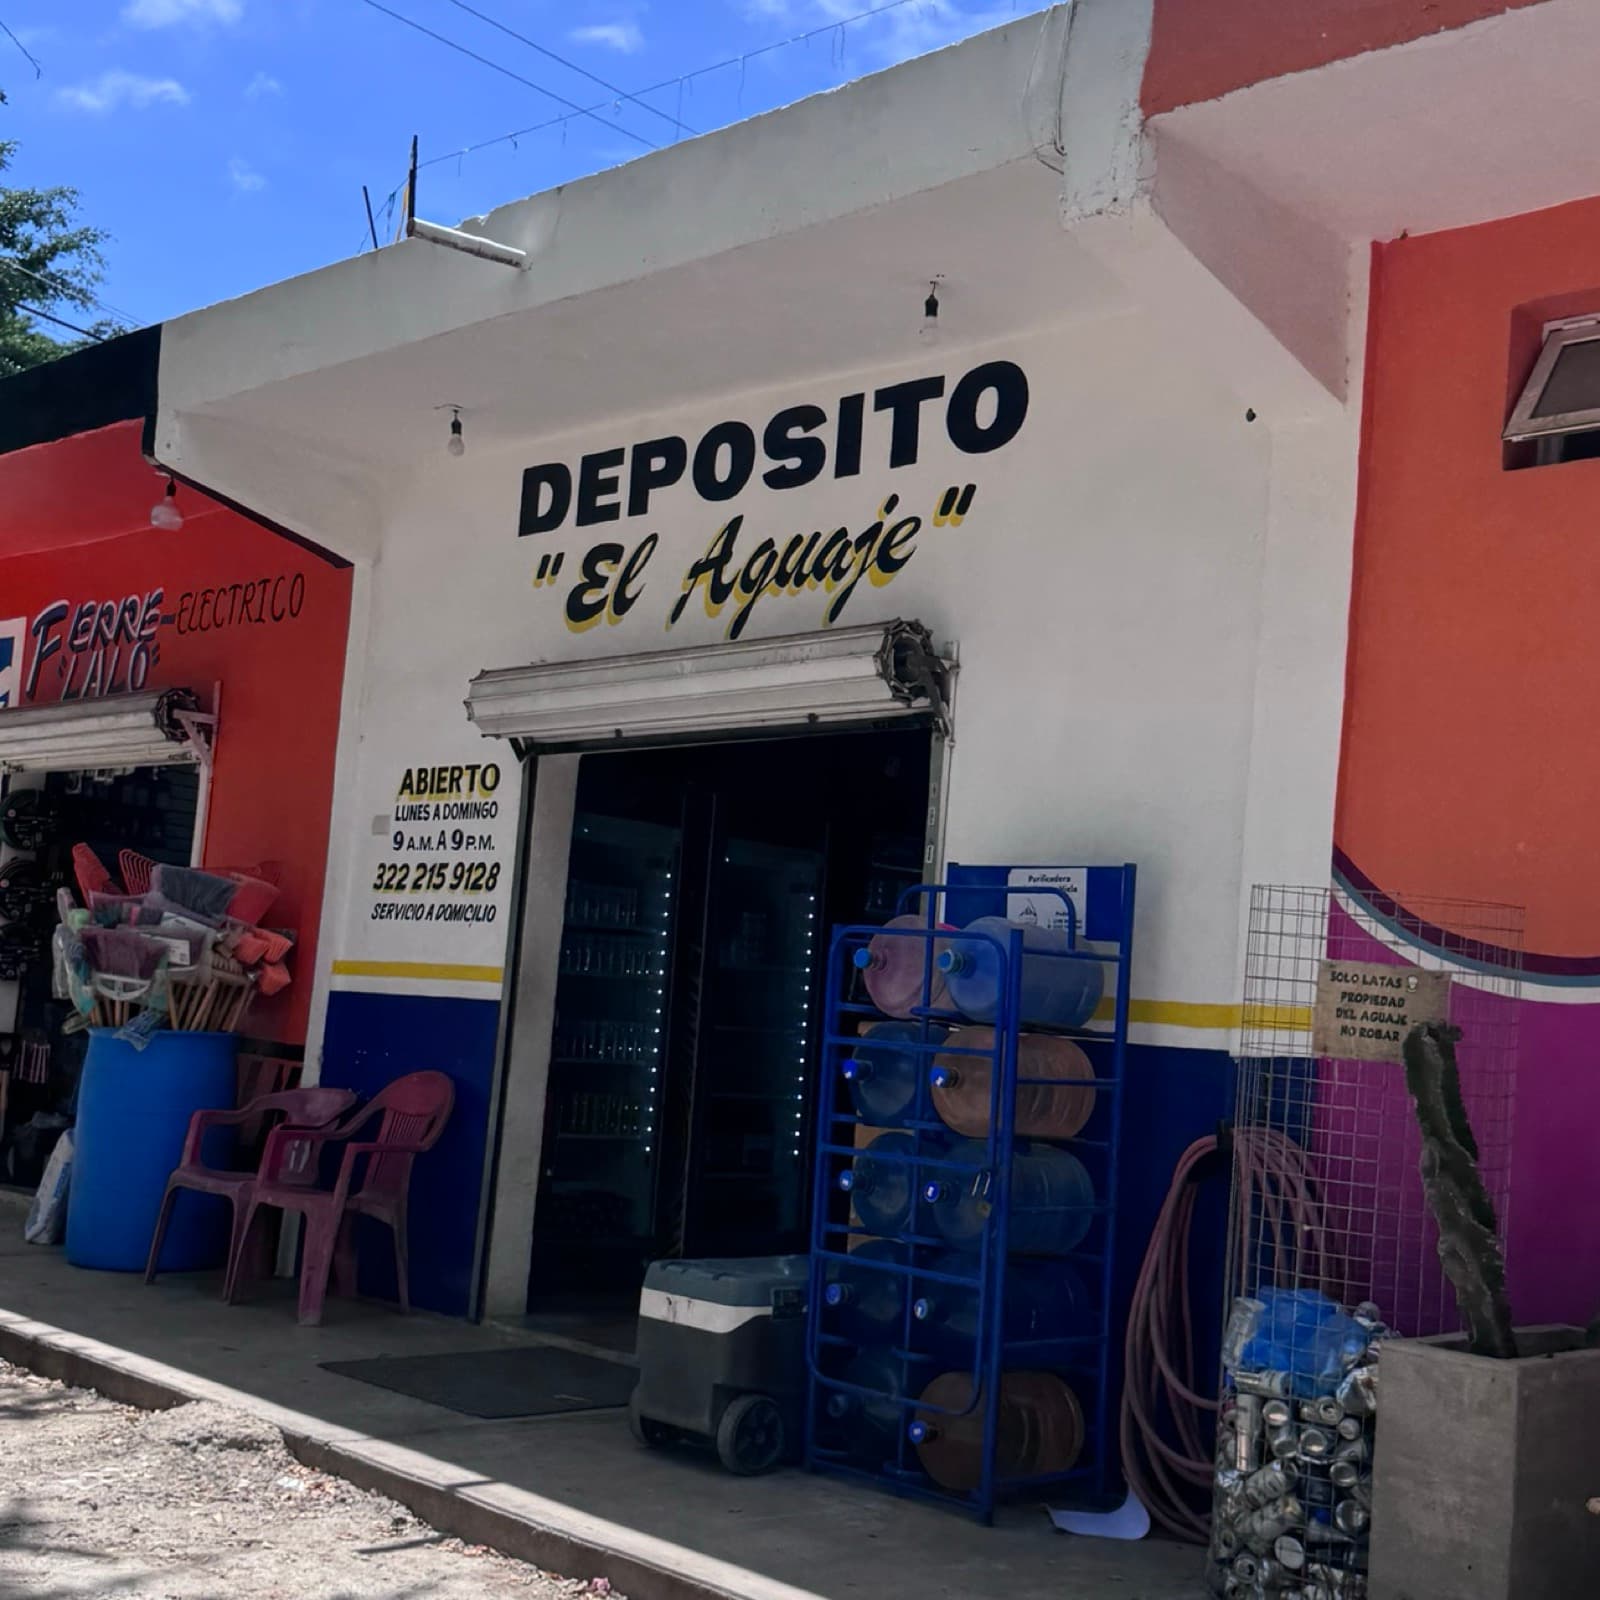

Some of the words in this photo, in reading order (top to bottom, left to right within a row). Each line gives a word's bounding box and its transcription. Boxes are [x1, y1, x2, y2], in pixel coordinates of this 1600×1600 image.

[518, 360, 1029, 537] DEPOSITO
[397, 763, 501, 801] ABIERTO
[395, 803, 430, 821] LUNES
[433, 804, 441, 821] A
[442, 801, 498, 820] DOMINGO
[393, 831, 404, 851] 9
[406, 836, 434, 851] A.M.
[436, 830, 447, 851] A
[451, 828, 464, 851] 9
[465, 834, 496, 851] P.M.
[373, 862, 410, 893] 322
[411, 862, 449, 893] 215
[450, 862, 501, 894] 9128
[371, 903, 425, 921] SERVICIO
[425, 904, 433, 921] A
[435, 903, 497, 923] DOMICILIO
[1330, 971, 1359, 984] SOLO
[1362, 974, 1403, 988] LATAS
[1341, 991, 1406, 1008] PROPIEDAD
[1336, 1008, 1357, 1021] DEL
[1360, 1011, 1408, 1027] AGUAJE
[1340, 1025, 1356, 1037] NO
[1358, 1027, 1400, 1042] ROBAR
